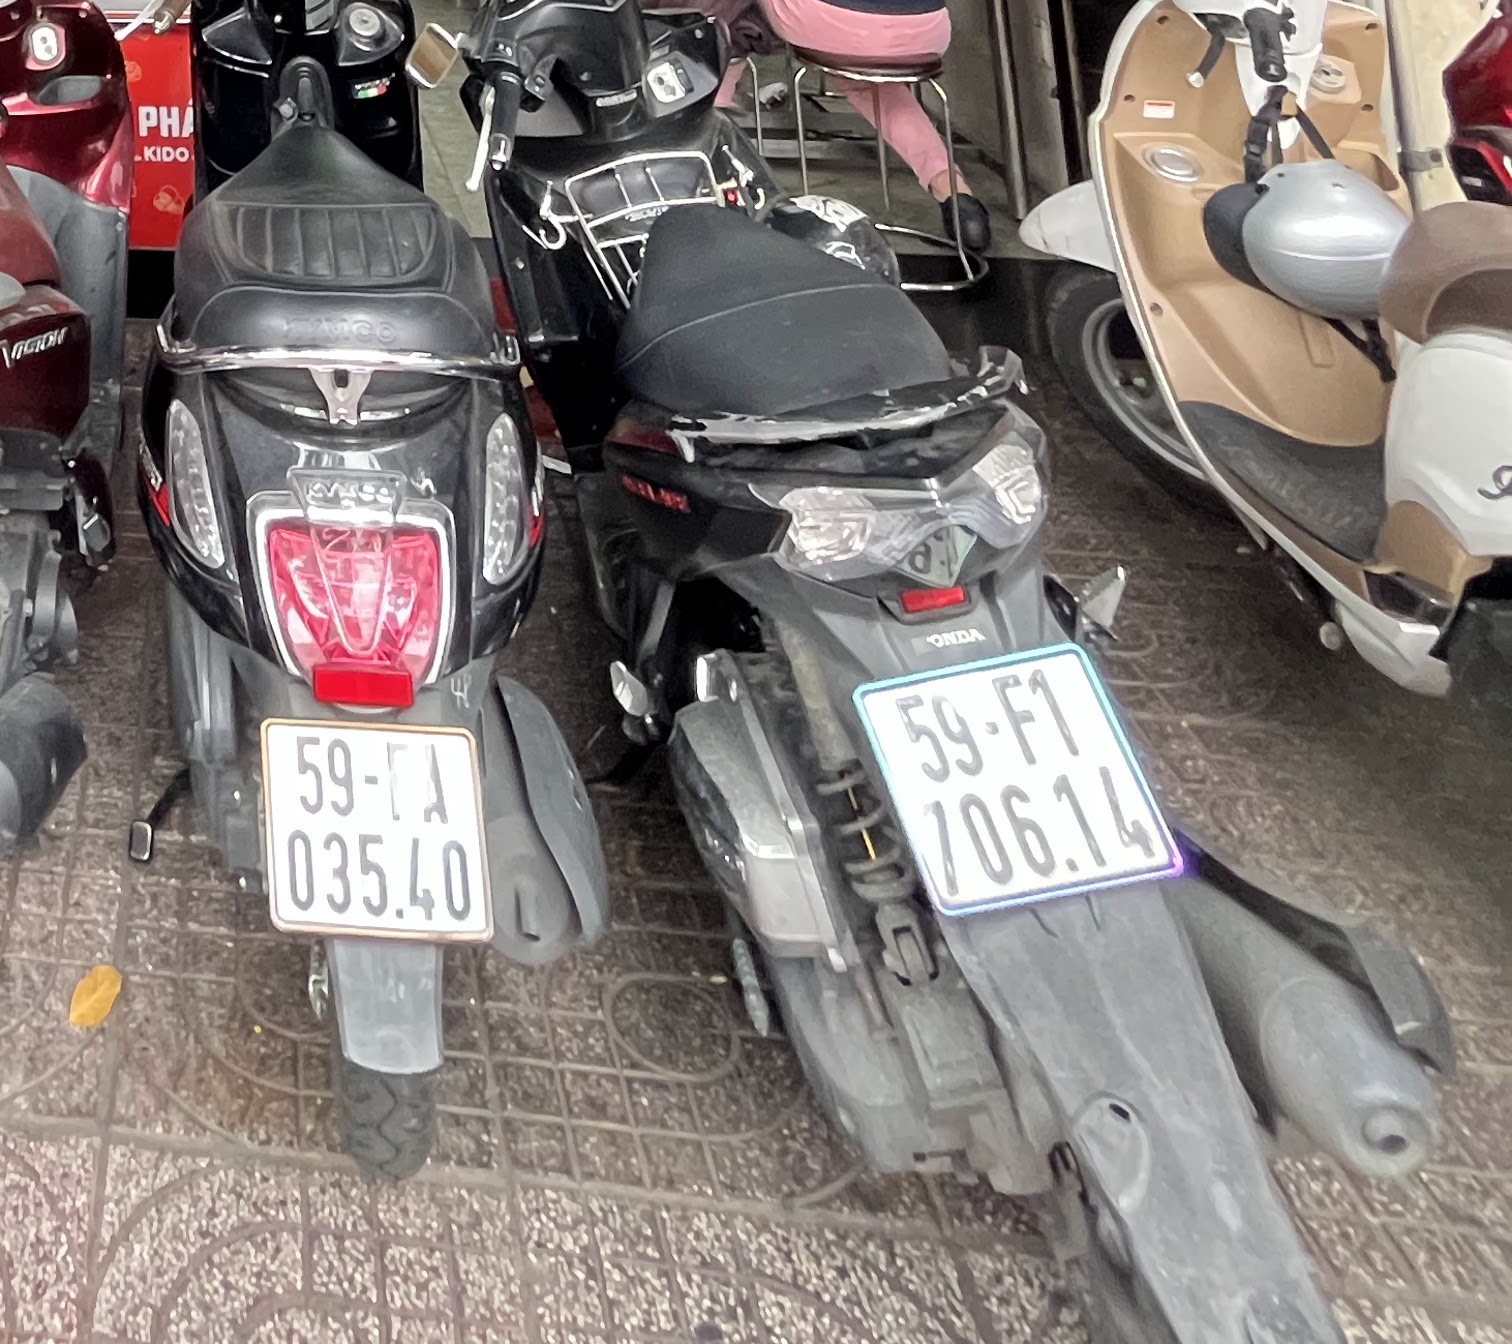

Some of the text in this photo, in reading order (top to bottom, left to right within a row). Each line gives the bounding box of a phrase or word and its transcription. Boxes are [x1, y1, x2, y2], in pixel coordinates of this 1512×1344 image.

[138, 98, 194, 138] PHÁ
[143, 145, 189, 162] KIDO
[926, 628, 987, 648] ONDA
[921, 765, 1157, 898] 706.14
[288, 830, 472, 922] 035.40
